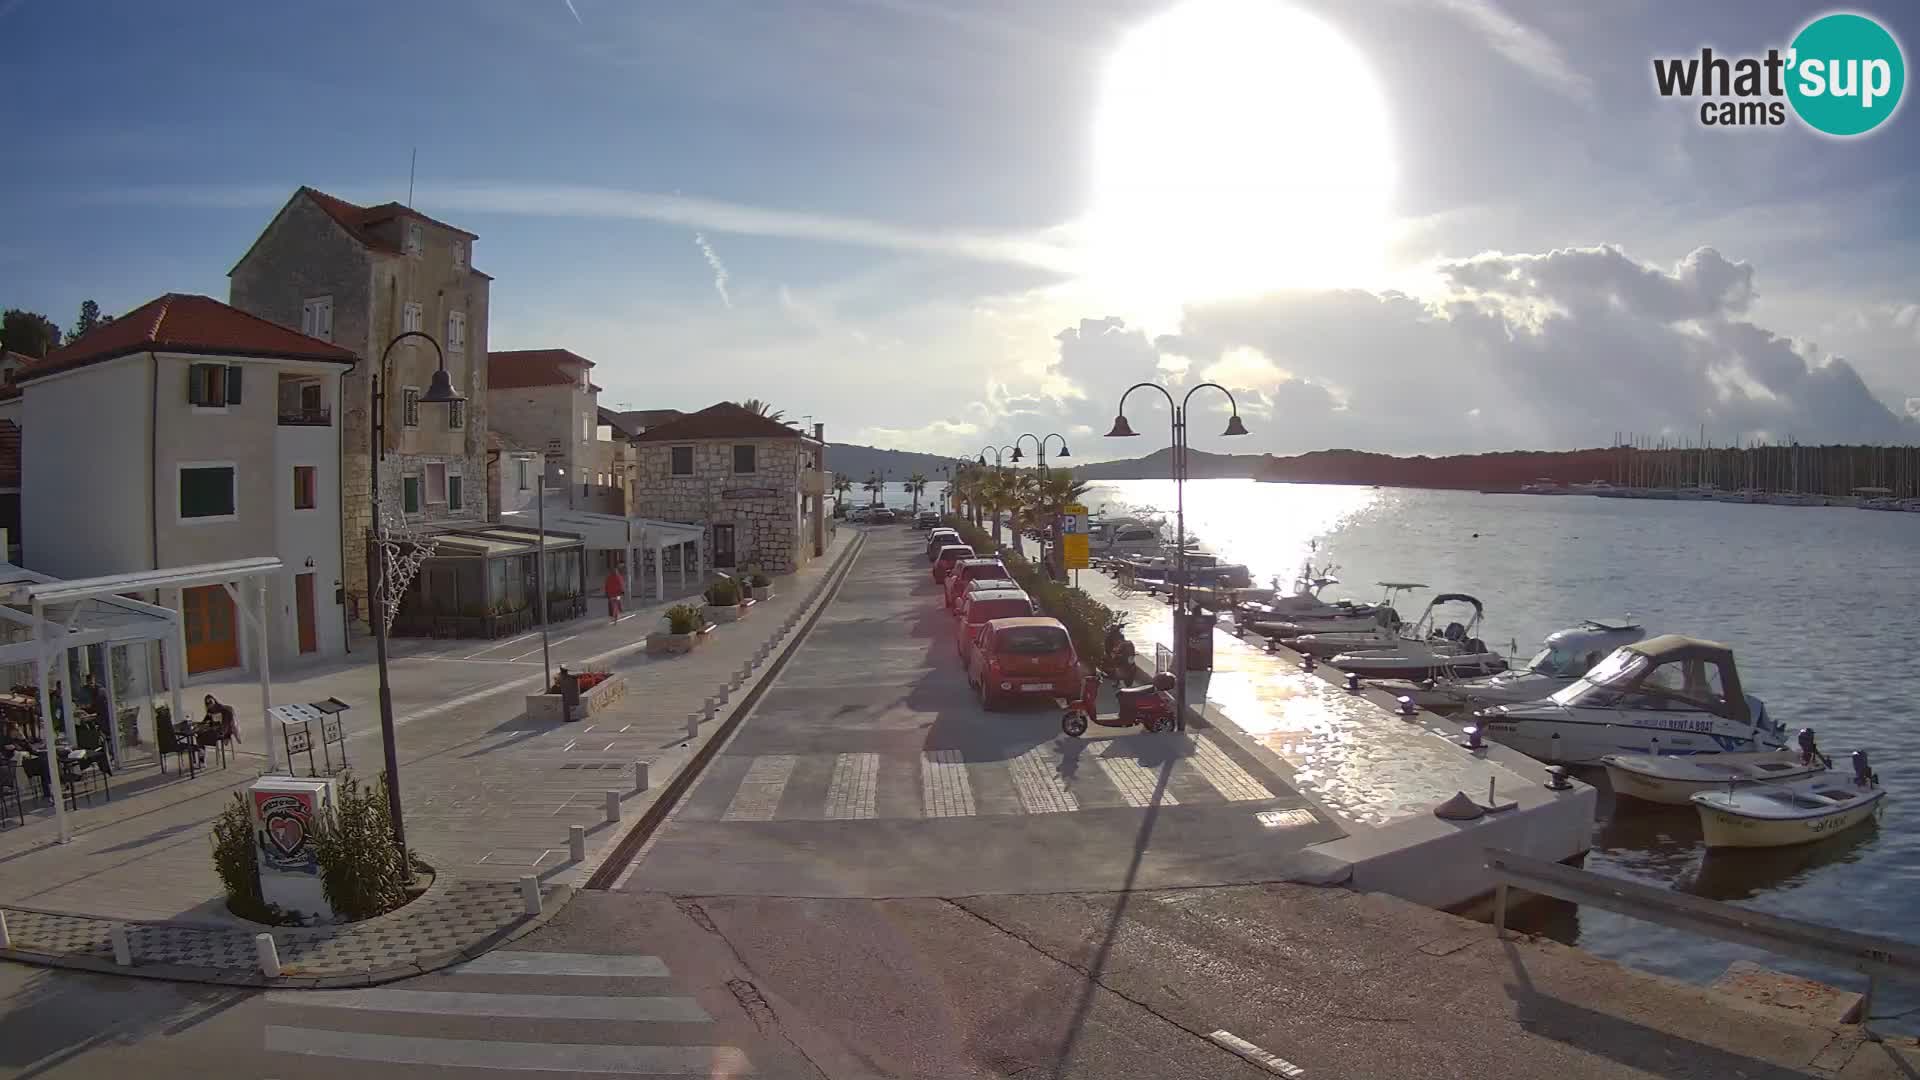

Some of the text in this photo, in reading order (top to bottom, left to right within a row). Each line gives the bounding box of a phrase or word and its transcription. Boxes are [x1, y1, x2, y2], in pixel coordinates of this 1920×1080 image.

[1065, 516, 1077, 532] P
[1668, 719, 1688, 730] RENT
[1695, 720, 1714, 733] BOAT
